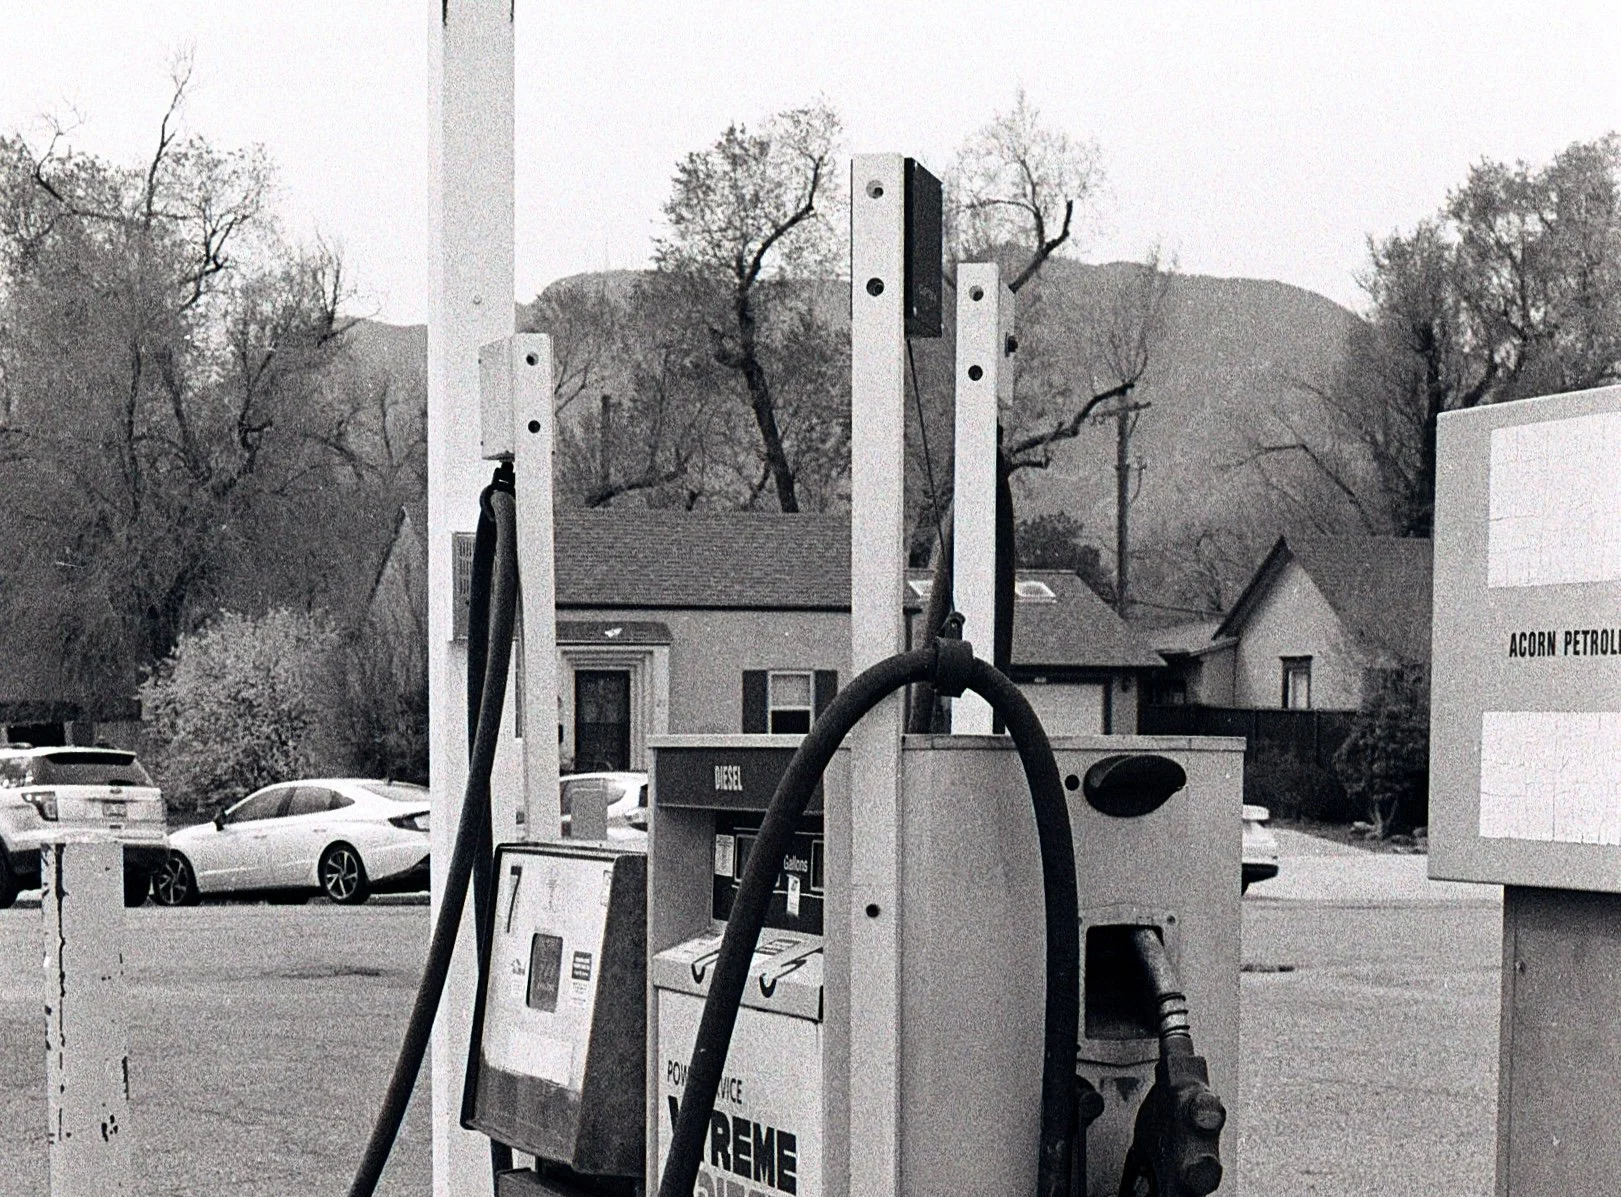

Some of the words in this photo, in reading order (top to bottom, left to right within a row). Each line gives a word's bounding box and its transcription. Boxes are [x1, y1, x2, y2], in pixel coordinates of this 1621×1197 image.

[1508, 631, 1556, 658] ACORN
[714, 765, 744, 791] DIESEL
[783, 854, 809, 873] Gallons
[717, 1076, 743, 1105] VICE
